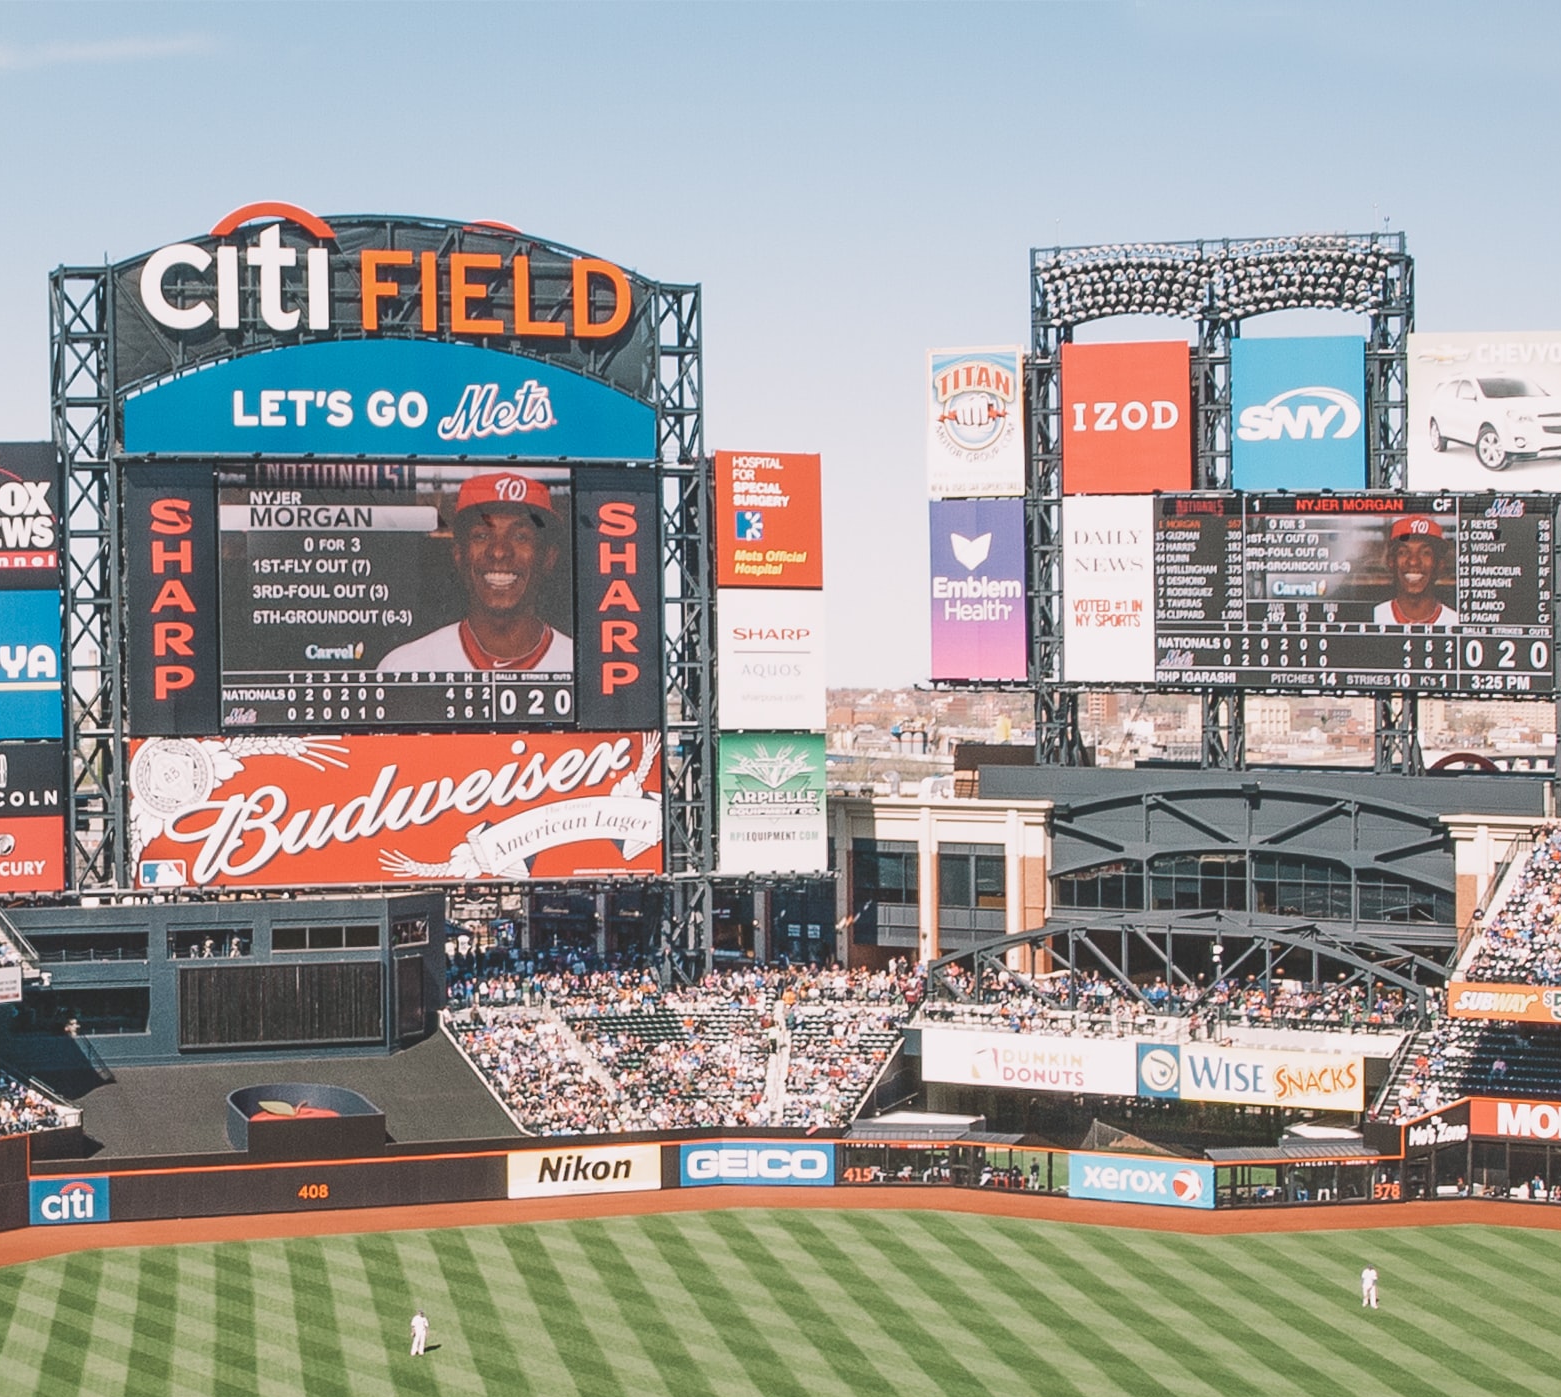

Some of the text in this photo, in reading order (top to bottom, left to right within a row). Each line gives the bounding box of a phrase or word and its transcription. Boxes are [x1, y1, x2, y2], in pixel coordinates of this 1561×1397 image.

[140, 224, 632, 338] citi FIELD
[939, 364, 1010, 396] TITAN
[233, 380, 557, 440] LET'S GO Mets
[1073, 401, 1178, 431] IZOD
[1237, 399, 1346, 441] SNY
[732, 456, 783, 469] HOSPITAL
[732, 469, 755, 481] FOR
[733, 482, 782, 494] SPECIAL
[249, 491, 302, 504] NYJER
[733, 494, 789, 508] SURGERY
[250, 508, 372, 527] MORGAN
[1074, 530, 1142, 545] DAILY
[735, 550, 807, 563] Mets Official
[1074, 557, 1143, 572] NEWS
[735, 563, 783, 576] Hospital
[933, 577, 1021, 599] Emblem
[150, 499, 196, 700] SHARP
[1073, 599, 1143, 612] VOTED #1 IN
[944, 599, 1009, 621] Health
[1076, 614, 1140, 627] NY SPORTS
[732, 628, 810, 641] SHARP
[305, 644, 354, 659] Carvel
[1158, 638, 1220, 649] NATIONALS
[741, 664, 801, 676] AQUOS
[731, 790, 818, 804] ARPIELLE
[164, 738, 631, 883] Budweiser
[492, 812, 652, 861] American Lager
[1454, 991, 1539, 1013] SUBWAY
[1002, 1067, 1085, 1087] DONUTS
[1188, 1055, 1357, 1099] WISE SNACKS
[538, 1156, 632, 1183] Nikon
[686, 1150, 828, 1179] GEICO
[843, 1167, 872, 1182] 415
[1082, 1166, 1167, 1195] xerox
[298, 1184, 329, 1199] 408
[1374, 1183, 1401, 1199] 378
[41, 1185, 93, 1220] citi
